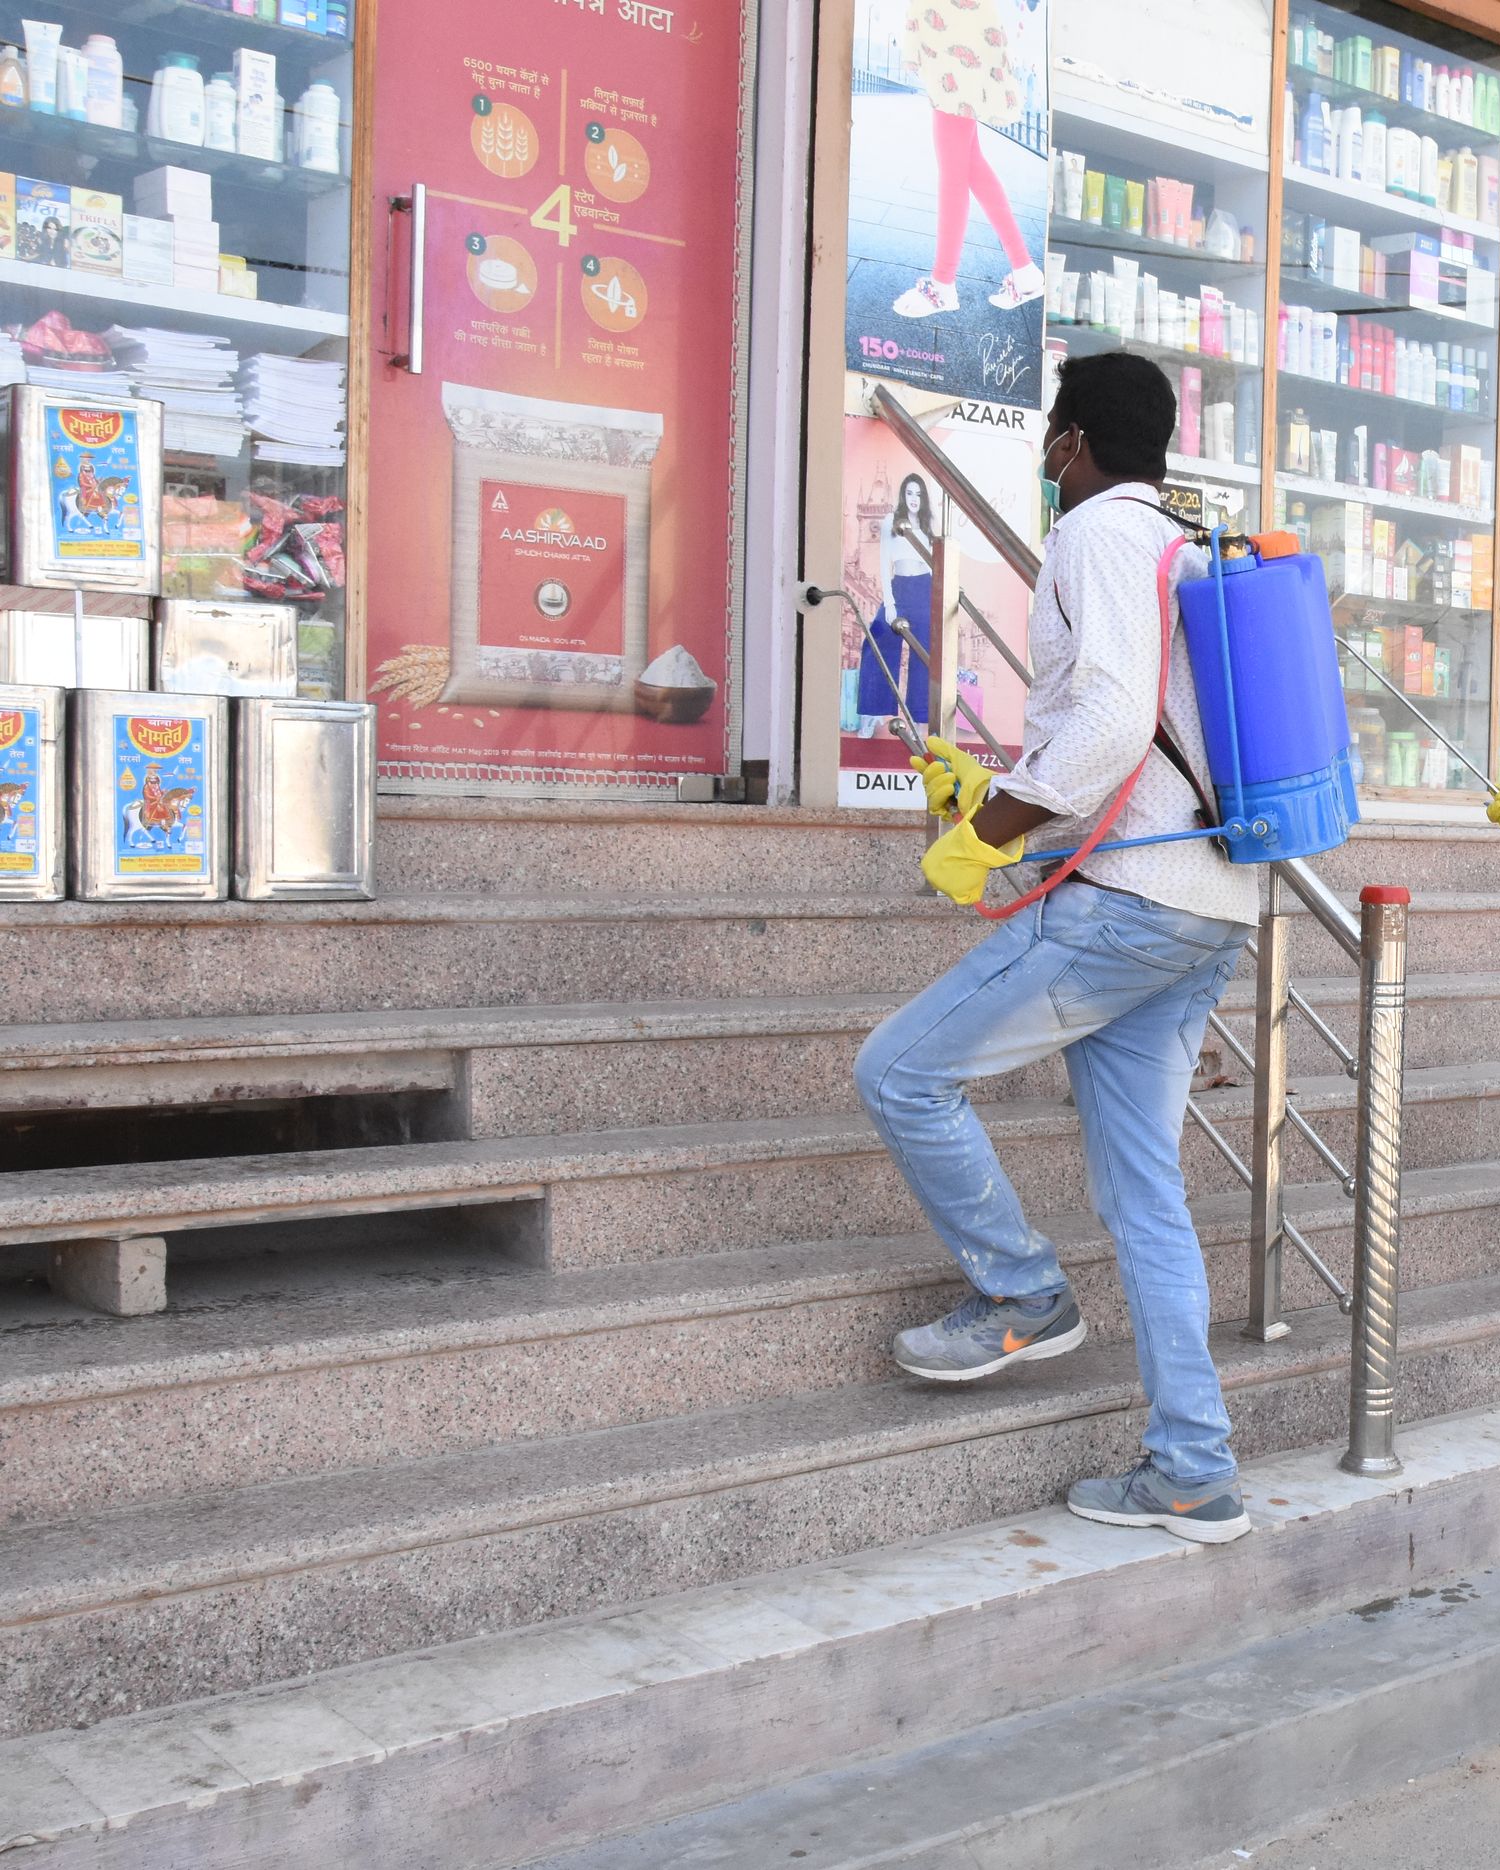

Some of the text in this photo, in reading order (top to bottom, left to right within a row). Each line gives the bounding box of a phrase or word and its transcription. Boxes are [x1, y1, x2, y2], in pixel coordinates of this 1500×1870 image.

[618, 0, 674, 33] आटा
[463, 57, 493, 72] 6500
[508, 82, 531, 95] जाता
[534, 85, 541, 100] है
[480, 99, 485, 111] 1
[651, 113, 657, 128] है
[591, 126, 599, 139] 2
[574, 188, 595, 204] स्टेप
[530, 184, 577, 247] 4
[472, 237, 480, 250] 3
[586, 260, 595, 272] 4
[906, 348, 945, 363] COLOURS
[945, 402, 1025, 431] AZAAR
[69, 415, 114, 439] रामदेव
[499, 527, 607, 551] AASHIRVAAD
[514, 548, 542, 557] SHUDH
[571, 554, 591, 562] ATTA
[529, 636, 550, 644] MAIDA
[570, 638, 586, 646] ATTA
[137, 724, 183, 748] रामदेव
[856, 773, 918, 791] DAILY
